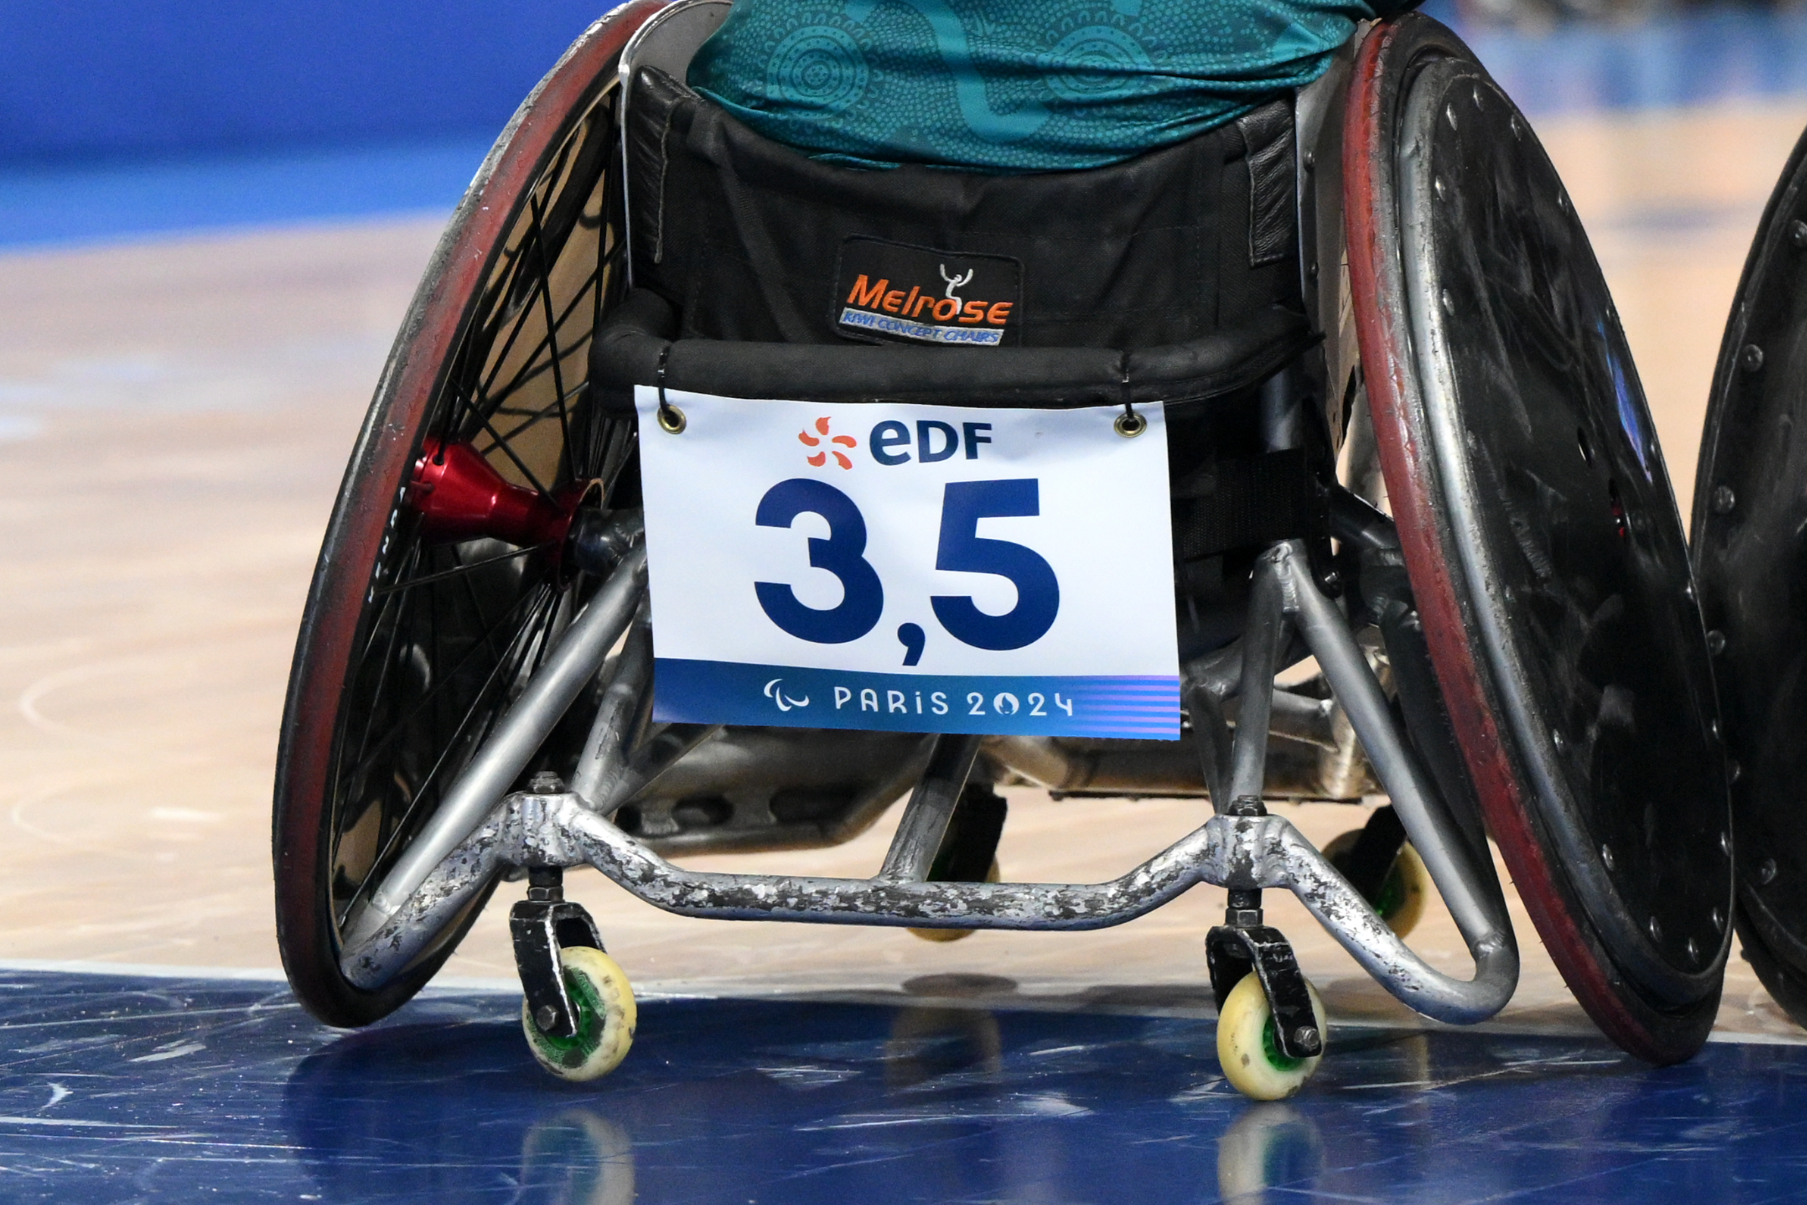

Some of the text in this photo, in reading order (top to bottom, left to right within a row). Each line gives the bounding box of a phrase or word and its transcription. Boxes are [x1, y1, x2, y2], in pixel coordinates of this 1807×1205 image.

[847, 274, 1013, 324] Melrose
[842, 311, 999, 343] KIWI CONCEPT CHAIRS
[754, 478, 1060, 667] 3,5
[834, 686, 1073, 717] PARIS 2024
